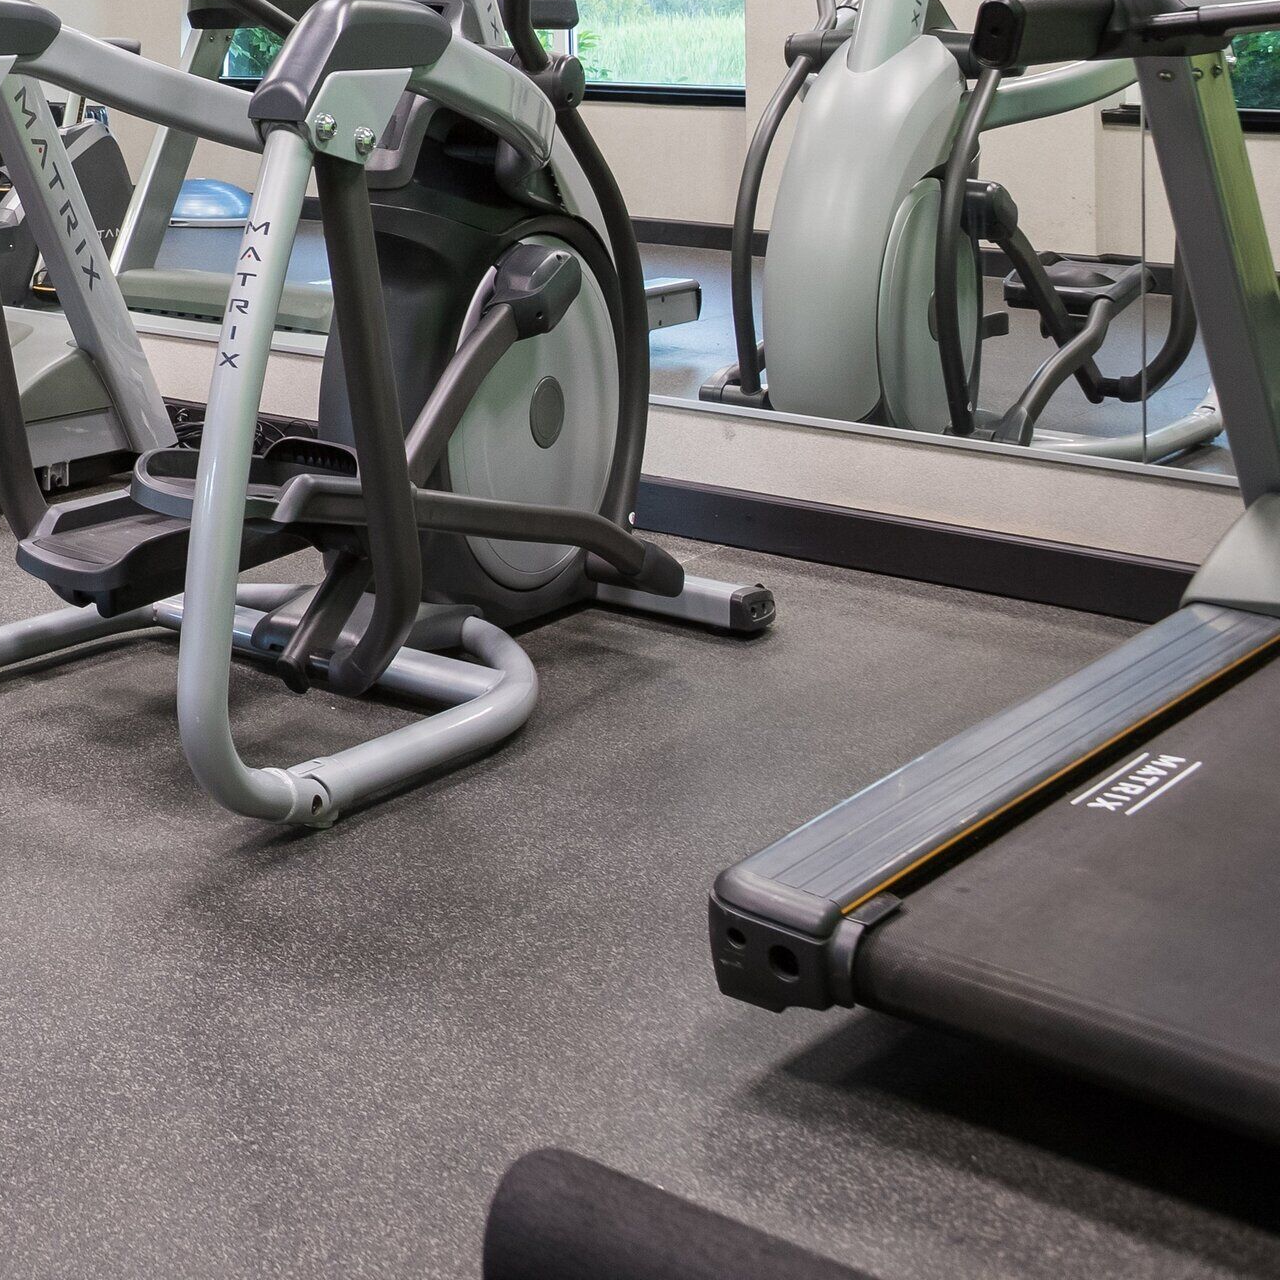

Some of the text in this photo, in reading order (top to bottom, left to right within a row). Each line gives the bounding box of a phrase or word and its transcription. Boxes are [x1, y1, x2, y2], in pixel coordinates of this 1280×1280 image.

[14, 86, 100, 291] MATRIX
[219, 221, 270, 369] MATRIX
[1087, 754, 1186, 811] MATRIX
